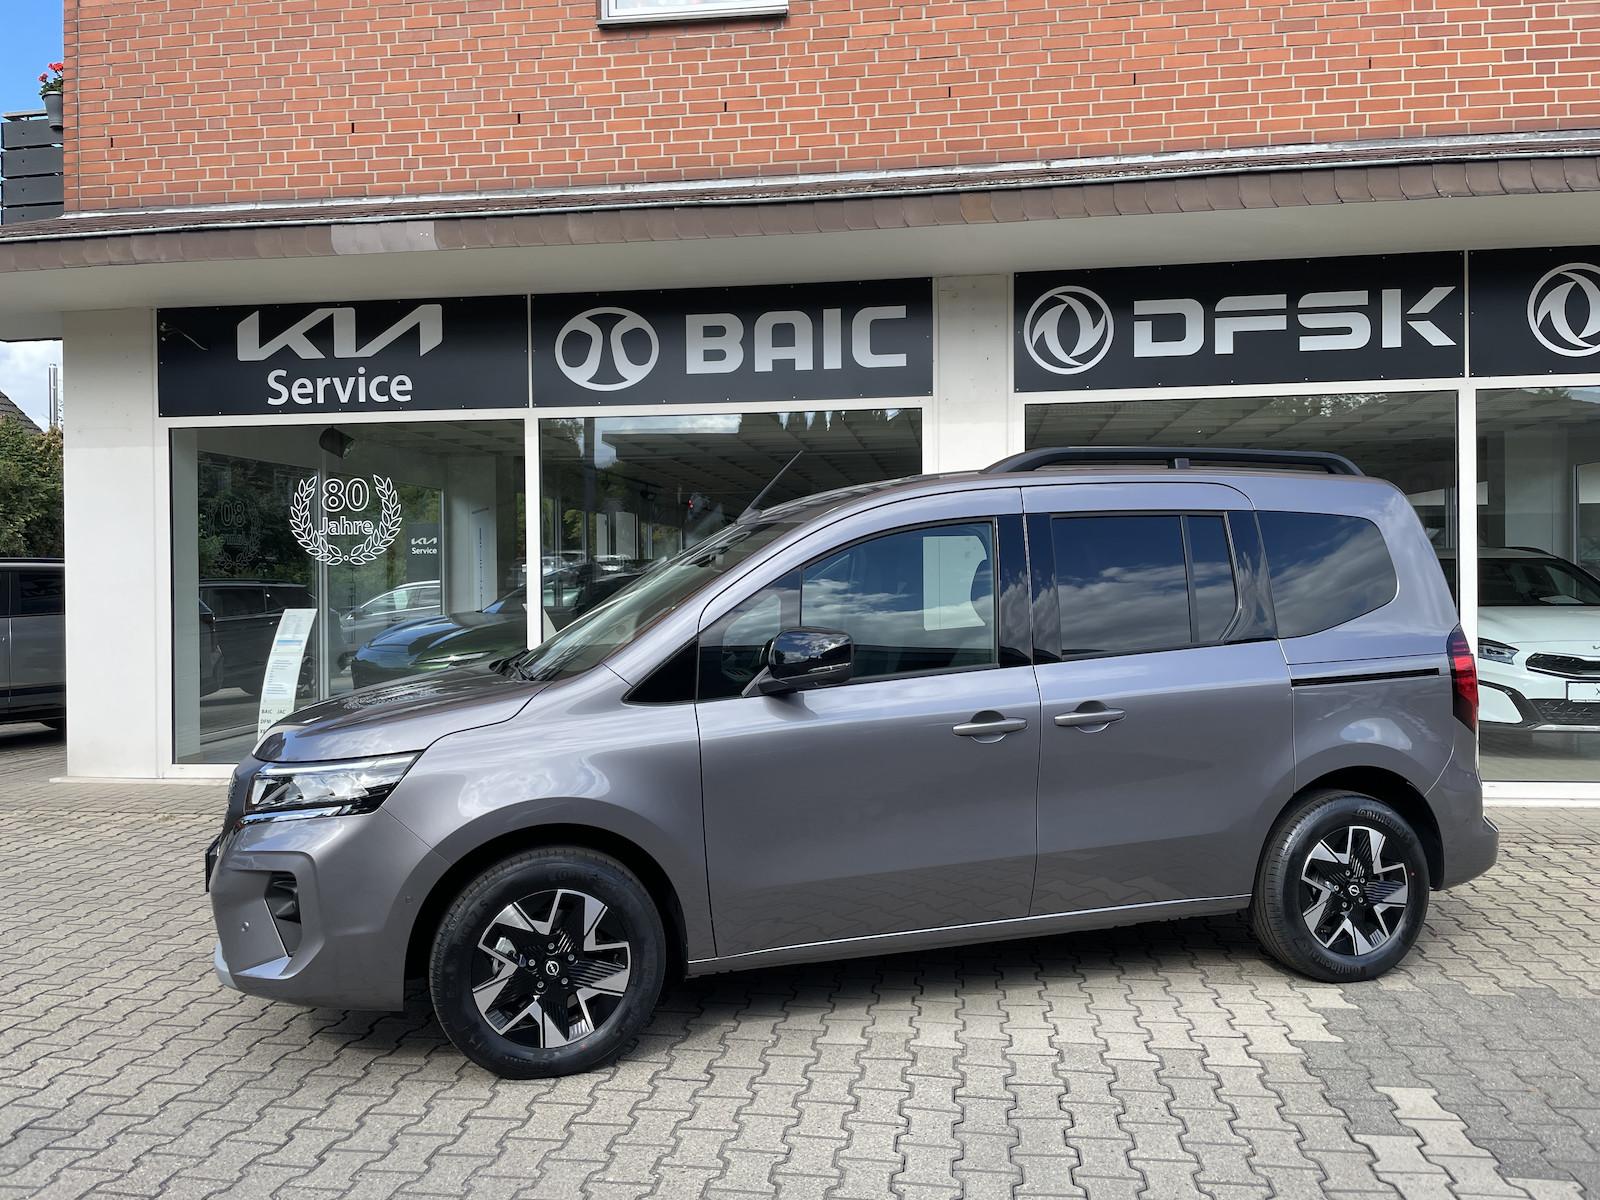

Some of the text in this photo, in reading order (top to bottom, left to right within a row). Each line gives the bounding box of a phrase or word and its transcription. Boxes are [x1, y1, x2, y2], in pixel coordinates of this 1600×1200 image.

[237, 303, 443, 362] KIA
[685, 305, 907, 375] BAIC
[1133, 286, 1457, 358] DFSK
[267, 366, 413, 406] Service
[322, 477, 370, 512] 80
[319, 515, 374, 536] Jahre
[411, 547, 438, 555] Service
